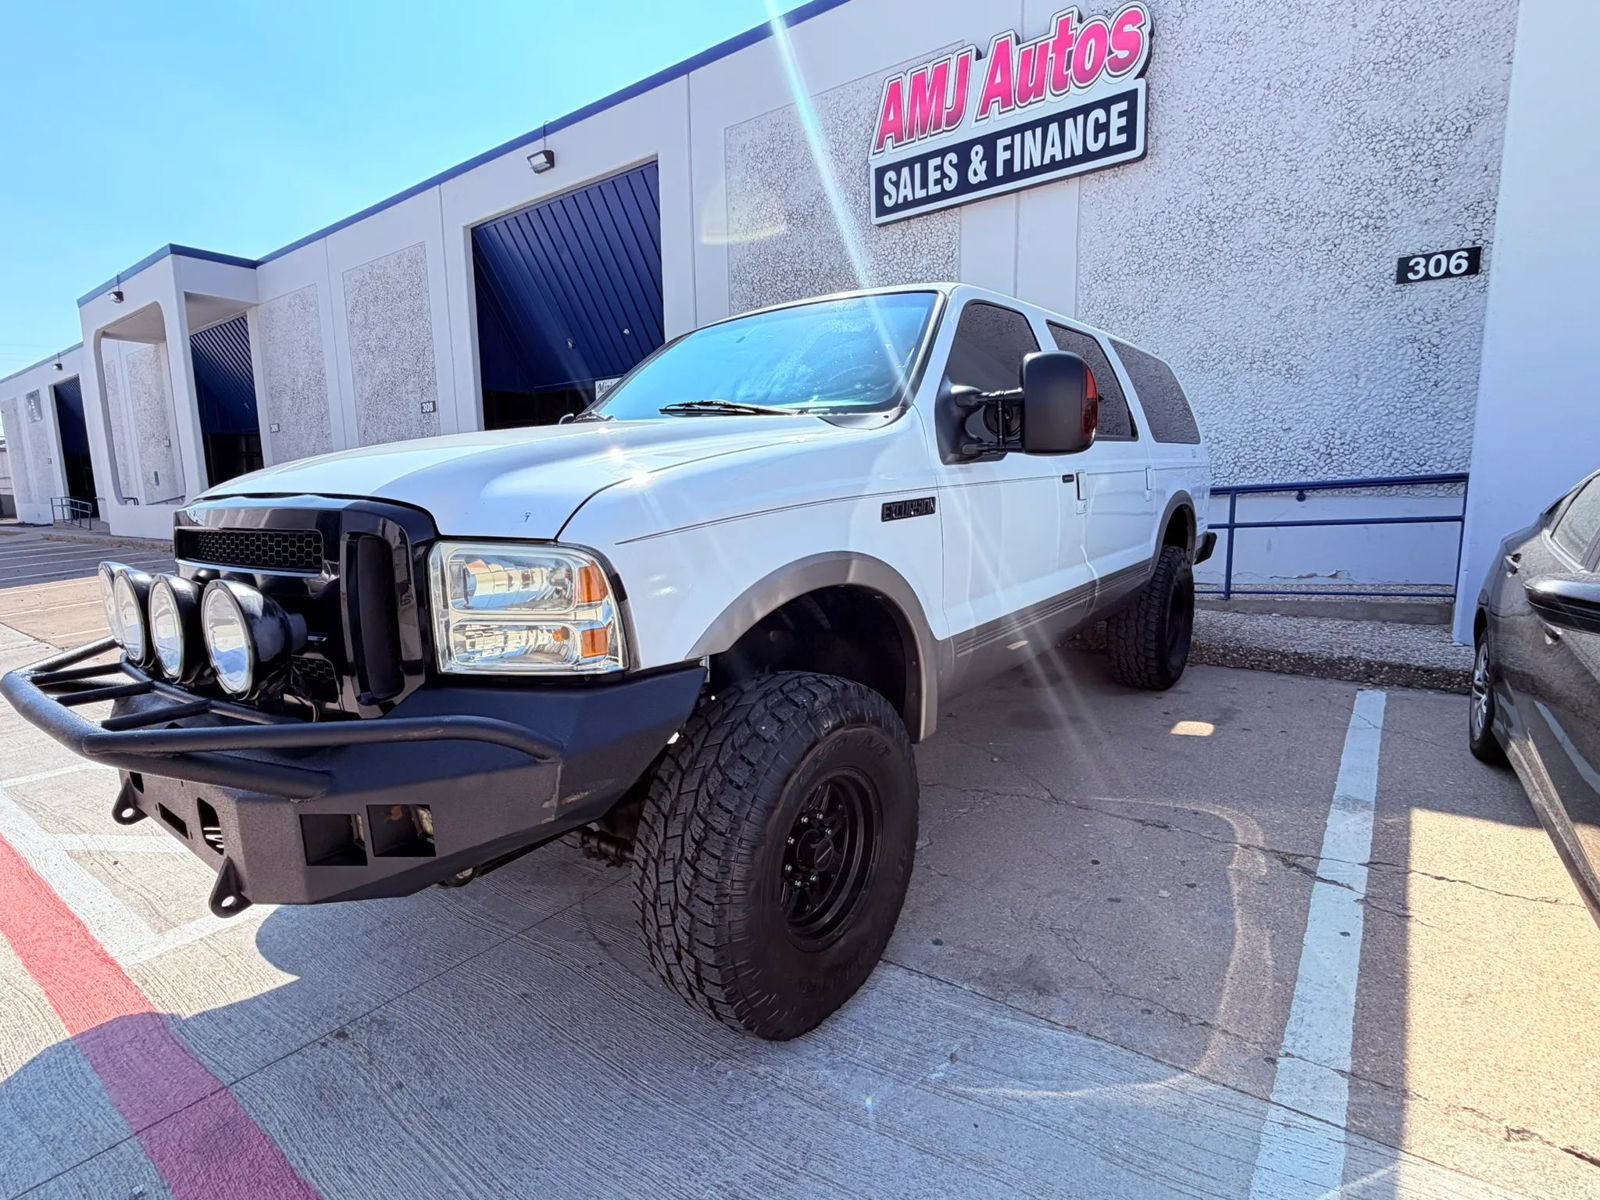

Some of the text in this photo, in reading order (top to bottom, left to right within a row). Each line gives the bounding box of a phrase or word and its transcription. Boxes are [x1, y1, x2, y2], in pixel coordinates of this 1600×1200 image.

[874, 7, 1147, 154] AMJ Autos
[882, 100, 1129, 208] SALES & FINANCE
[1406, 250, 1470, 281] 306
[883, 498, 936, 520] EXCURSION
